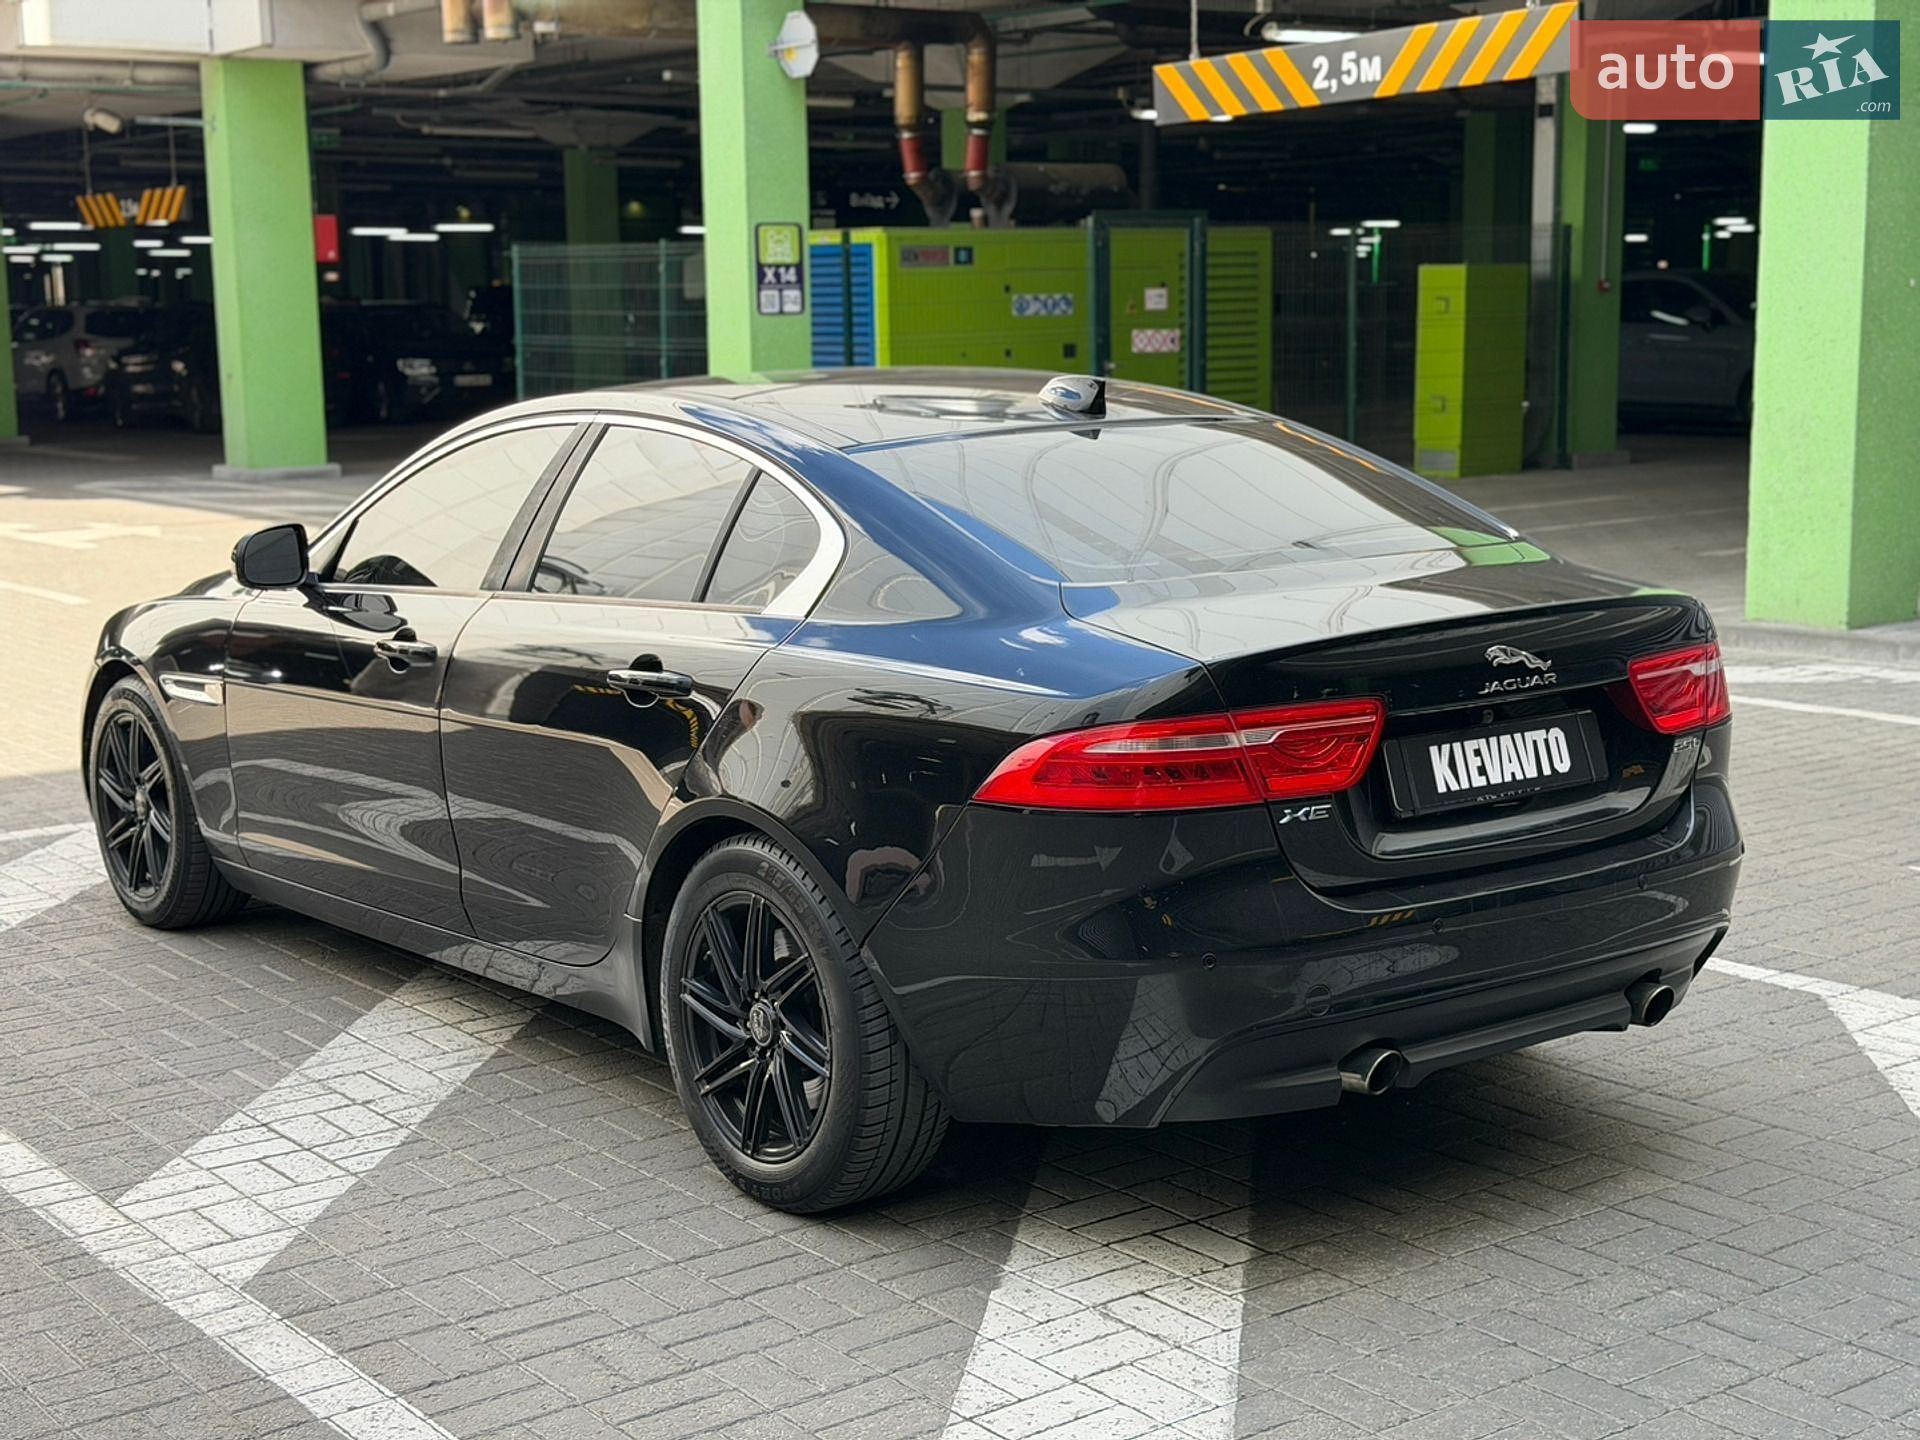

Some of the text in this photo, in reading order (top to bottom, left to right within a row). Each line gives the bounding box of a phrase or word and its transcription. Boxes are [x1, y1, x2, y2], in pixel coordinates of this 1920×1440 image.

[1478, 672, 1557, 695] JAGUAR
[1428, 727, 1572, 794] KIEVAVTO
[1279, 804, 1332, 824] XE
